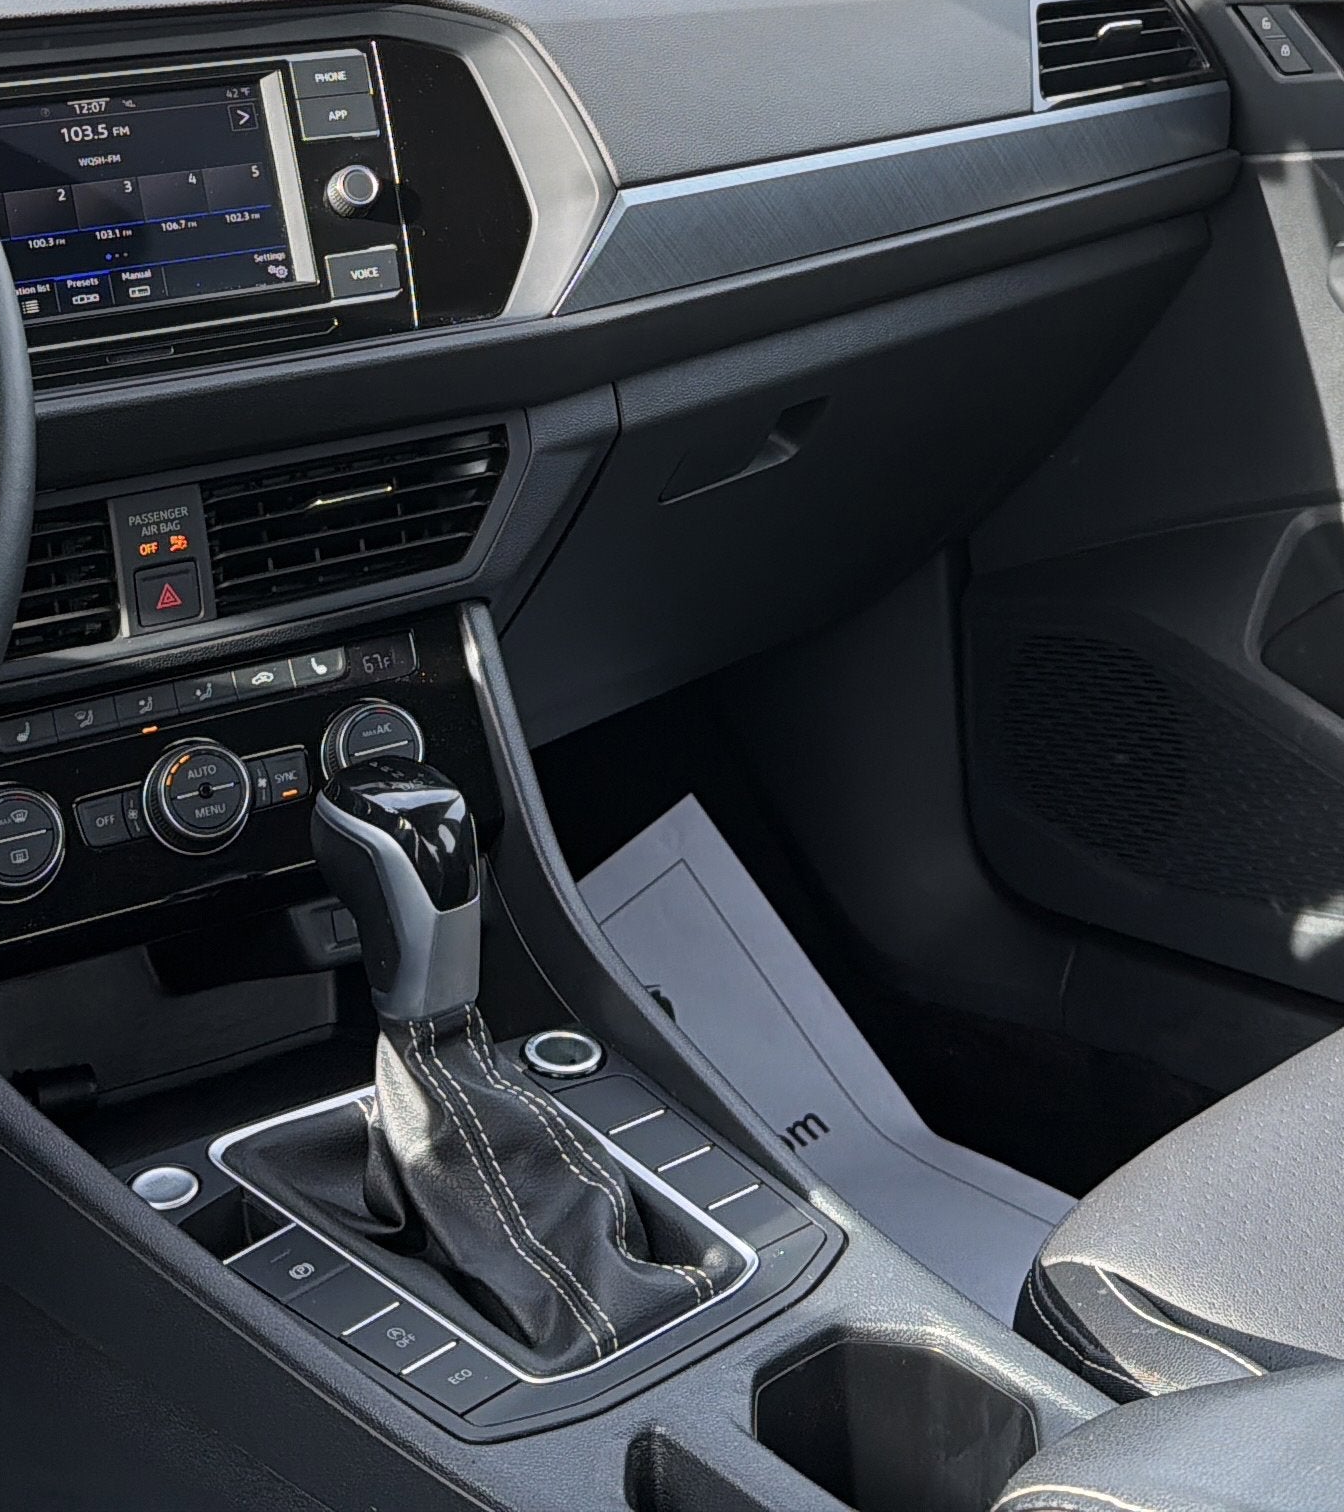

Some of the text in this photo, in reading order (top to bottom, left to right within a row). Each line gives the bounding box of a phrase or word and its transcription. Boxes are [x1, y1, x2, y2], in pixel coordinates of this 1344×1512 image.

[314, 70, 347, 83] PHONE
[74, 100, 107, 115] 12:07
[328, 110, 348, 122] APP
[60, 124, 131, 144] 103.5 FM
[78, 154, 121, 168] WQSH-FM
[251, 165, 260, 178] 5
[188, 173, 197, 185] 4
[123, 181, 133, 193] 3
[56, 189, 67, 201] 2
[224, 212, 250, 224] 102.3
[161, 220, 187, 232] 106.7
[95, 229, 121, 241] 103.1
[27, 238, 55, 250] 100.3
[254, 251, 286, 264] Settings
[122, 268, 152, 281] Manual
[350, 267, 380, 280] VOICE
[67, 276, 99, 289] Presets
[128, 506, 189, 527] PASSENGER
[141, 520, 181, 537] AIR BAG
[139, 541, 158, 556] OFF
[187, 764, 217, 780] AUTO
[274, 770, 298, 784] SYNC
[194, 803, 226, 819] MENU
[95, 815, 116, 828] OFF
[396, 1333, 416, 1348] OFF
[448, 1368, 473, 1385] ECO
